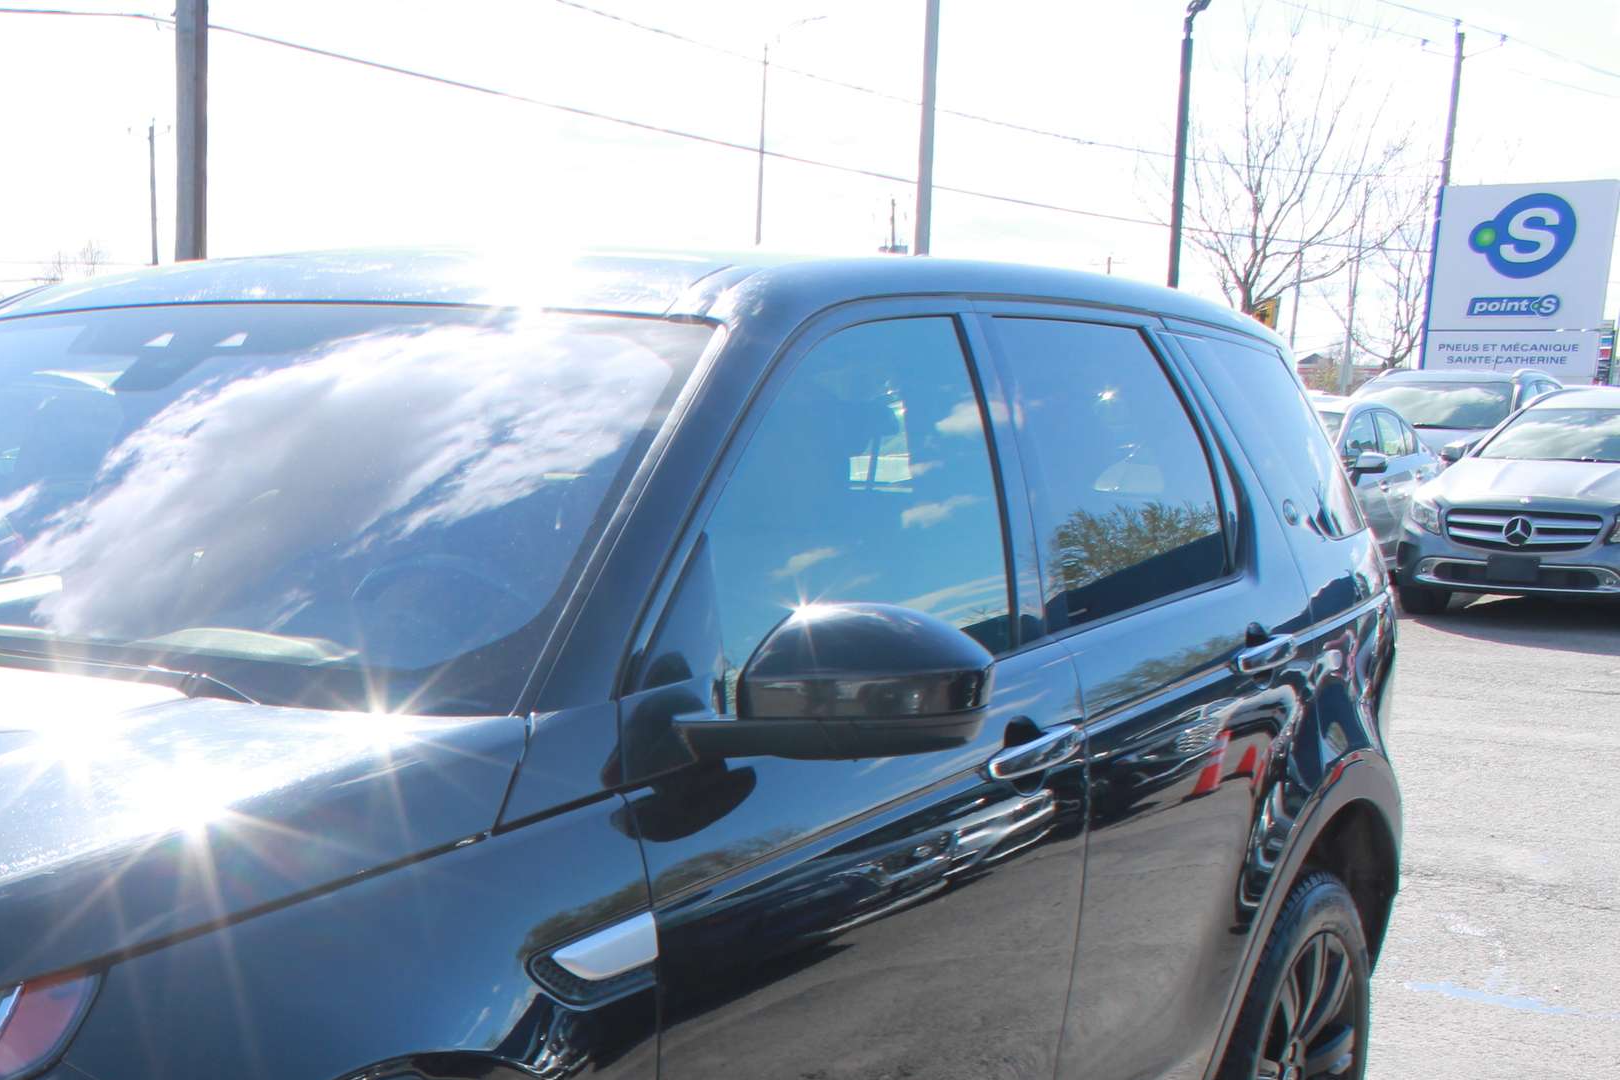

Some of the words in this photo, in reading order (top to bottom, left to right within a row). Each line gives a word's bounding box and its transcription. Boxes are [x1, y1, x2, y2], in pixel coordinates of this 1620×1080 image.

[1473, 298, 1529, 314] point
[1438, 343, 1480, 352] PNEUS
[1482, 343, 1498, 352] ET
[1501, 340, 1579, 352] MÉCANIQUE
[1446, 355, 1568, 365] SAINTE-CATHERINE
